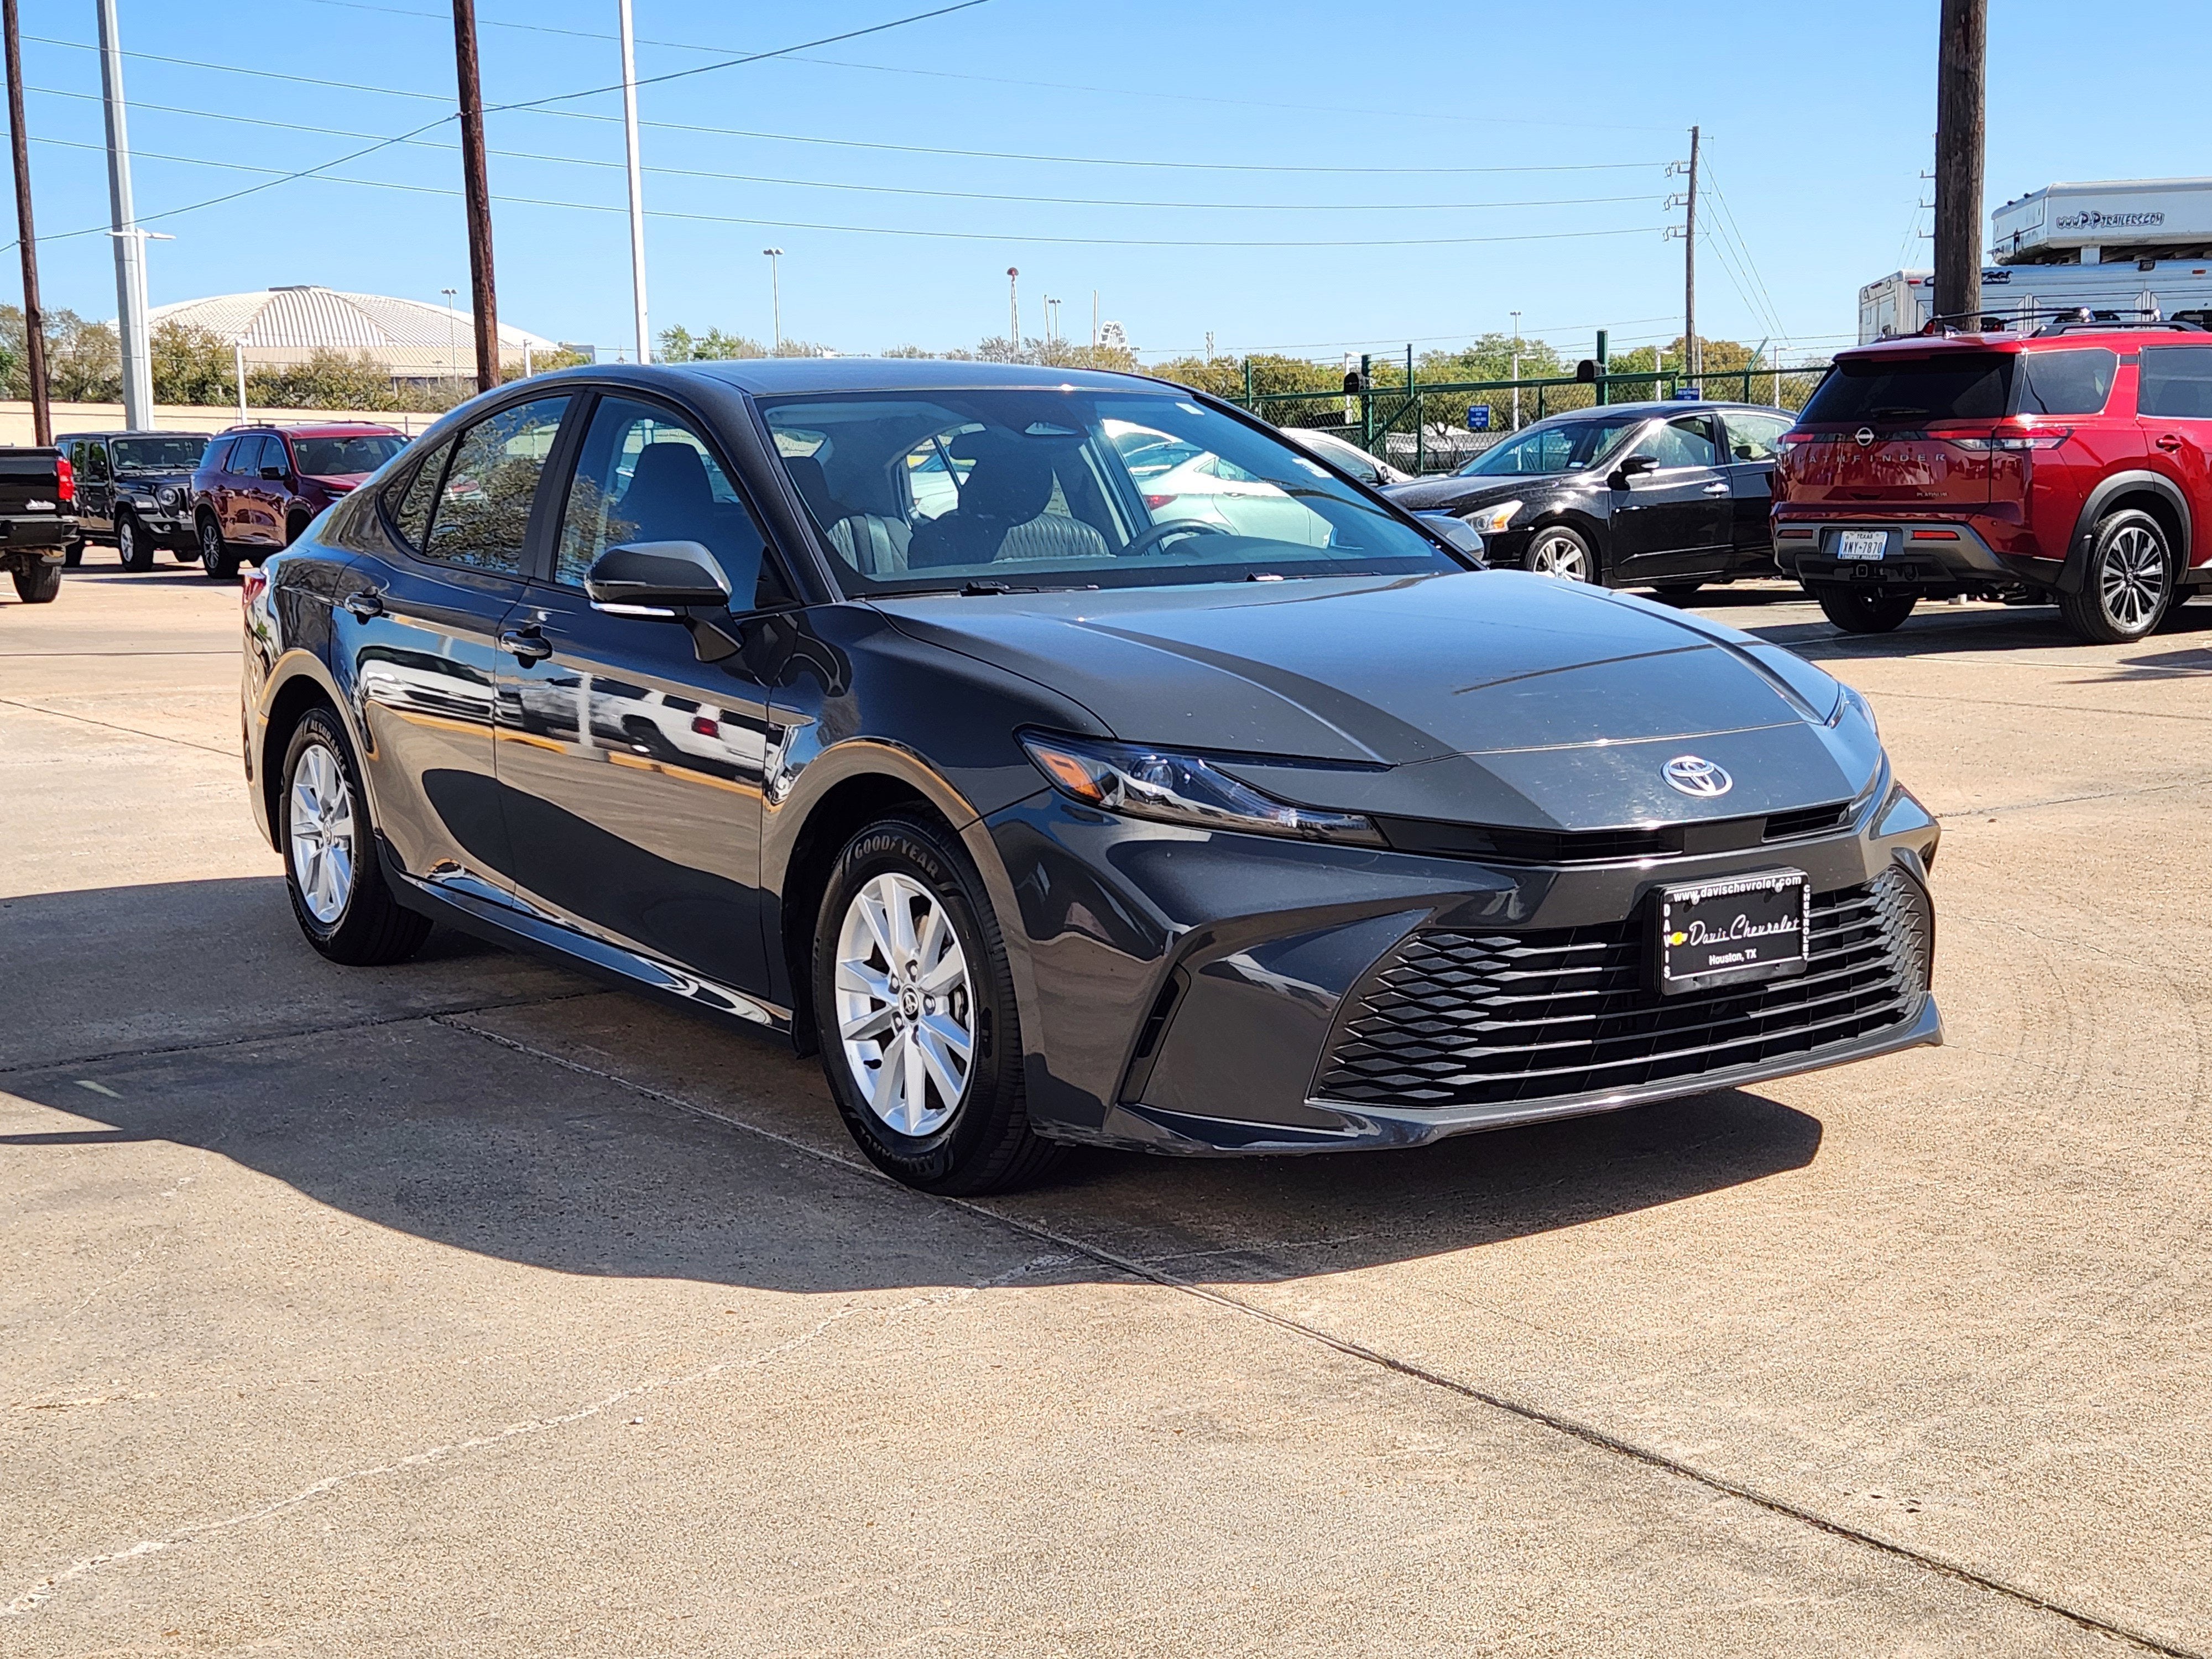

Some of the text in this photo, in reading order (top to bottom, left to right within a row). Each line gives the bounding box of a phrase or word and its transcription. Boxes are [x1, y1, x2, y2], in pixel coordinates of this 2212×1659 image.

[1798, 453, 1945, 463] PATHFINDER
[1673, 875, 1802, 902] www.davischevrolet.com
[1689, 914, 1802, 946] Davis Chevrolet
[1803, 884, 1811, 961] CHEVROLET
[1663, 903, 1671, 979] DAVIS
[1709, 948, 1757, 966] Houston, TX
